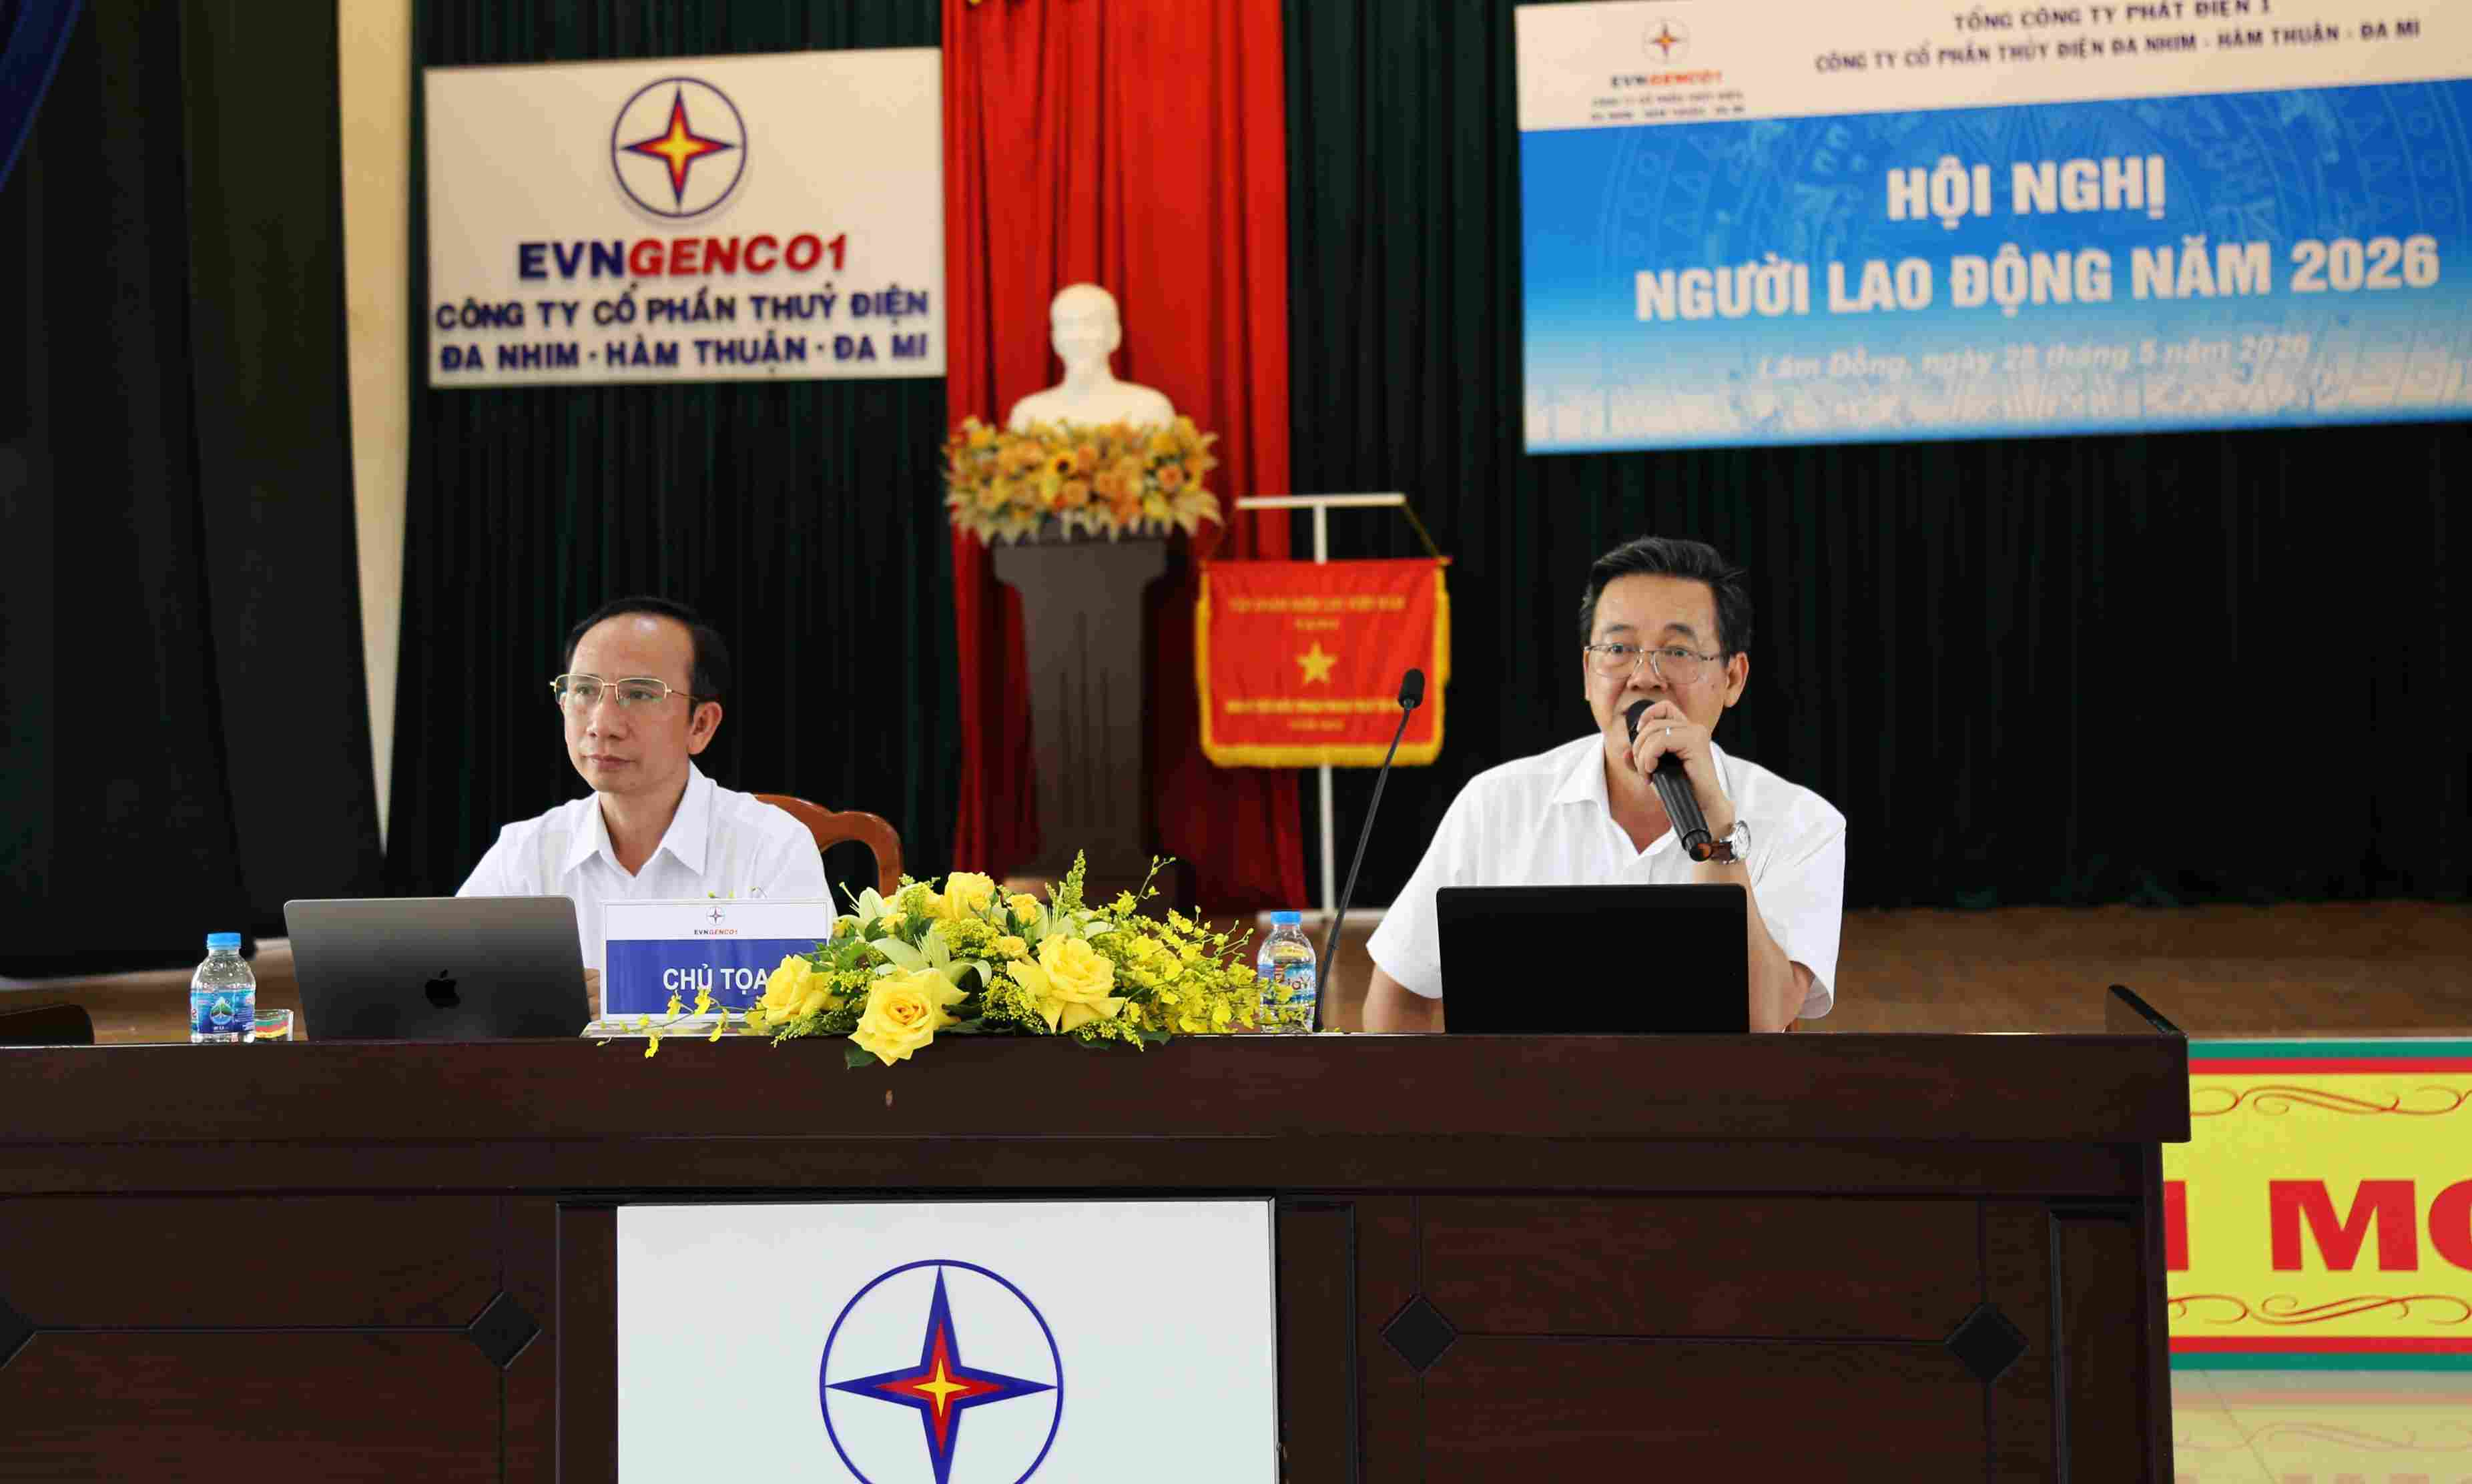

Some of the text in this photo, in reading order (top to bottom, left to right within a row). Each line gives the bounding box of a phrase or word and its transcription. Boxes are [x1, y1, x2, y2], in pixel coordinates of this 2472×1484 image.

[1955, 3, 2012, 30] TỔNG
[2021, 7, 2081, 27] CÔNG
[2091, 7, 2115, 24] TY
[2126, 0, 2184, 21] PHÁT
[1815, 51, 1868, 73] CÔNG
[1873, 51, 1897, 69] TY
[1903, 38, 1931, 67] CỔ
[2145, 34, 2197, 53] NHIM
[2395, 19, 2421, 38] MI
[1886, 153, 2166, 230] HỘI NGHỊ
[519, 232, 847, 280] EVNGENCO1
[1635, 233, 2441, 322] NGƯỜI LAO ĐỘNG NĂM 2026
[436, 298, 525, 330] CÔNG
[537, 300, 581, 328] TY
[593, 281, 639, 326] CỔ
[749, 280, 837, 321] THUỶ
[850, 282, 928, 326] ĐIỆN
[440, 343, 484, 371] ĐA
[498, 341, 580, 370] NHIM
[606, 333, 679, 368] HÀM
[693, 330, 808, 374] THUẬN
[833, 334, 877, 362] ĐA
[892, 332, 928, 359] MI
[663, 963, 769, 995] CHỦ TỌA
